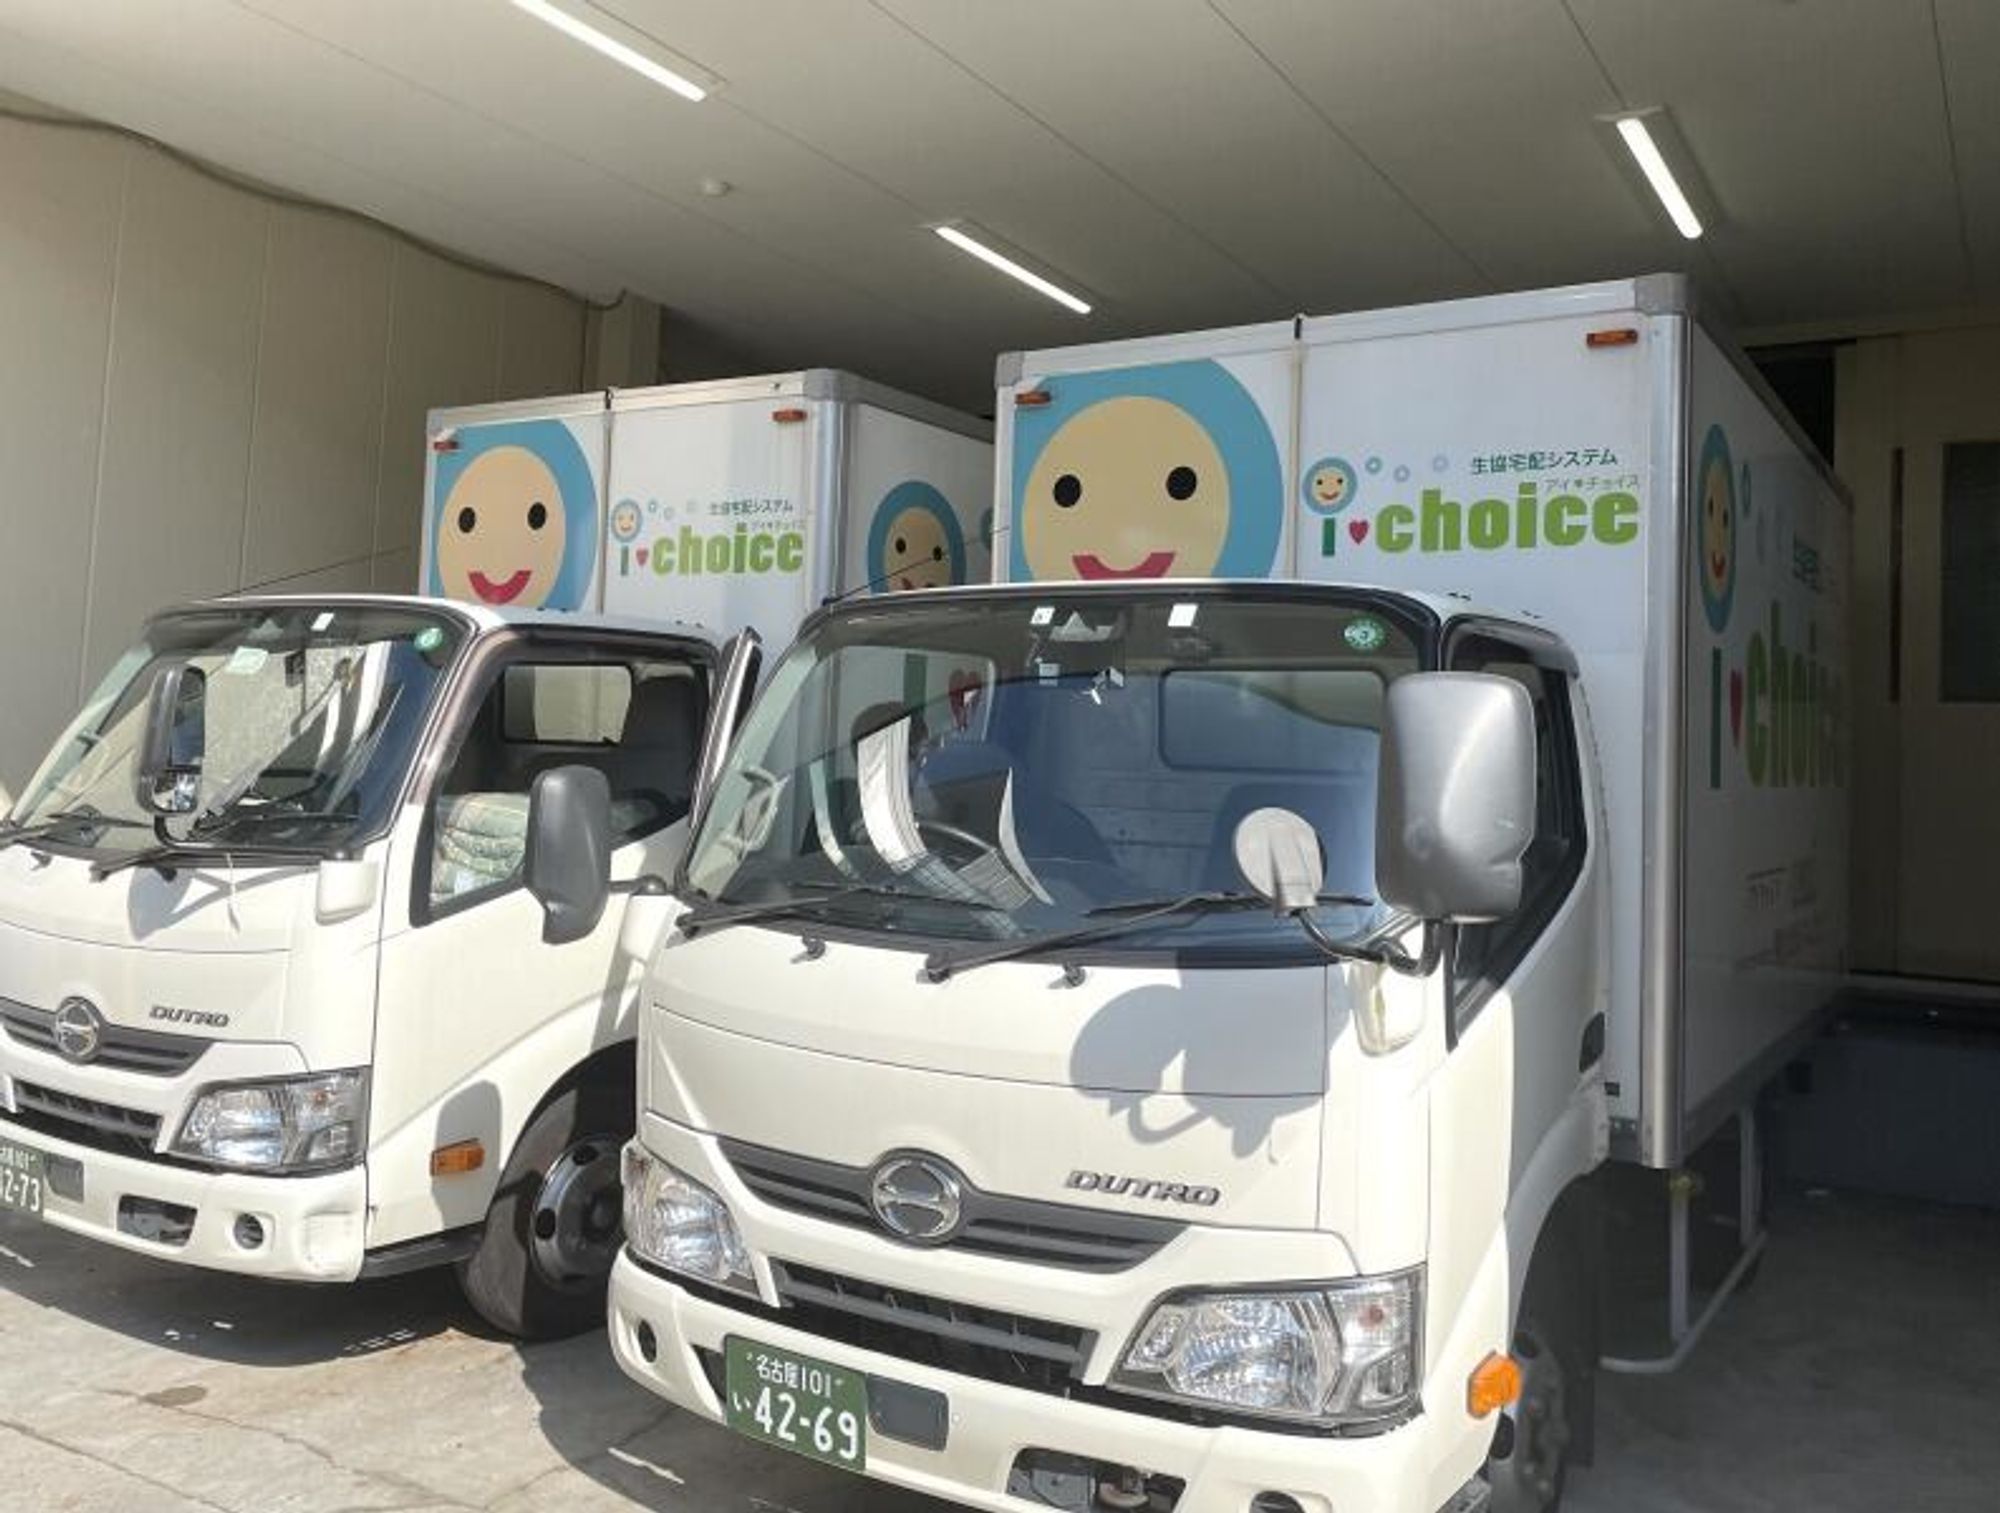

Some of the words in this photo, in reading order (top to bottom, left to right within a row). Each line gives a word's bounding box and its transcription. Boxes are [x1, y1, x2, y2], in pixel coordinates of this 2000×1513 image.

[1471, 449, 1618, 475] 生協宅配システム
[1375, 482, 1639, 554] choice
[652, 525, 804, 578] choice
[149, 1005, 229, 1028] DUTRO
[1066, 1170, 1221, 1206] DUTRO
[756, 1354, 798, 1388] 名古屋
[801, 1366, 832, 1399] 101
[755, 1386, 858, 1460] 42-69
